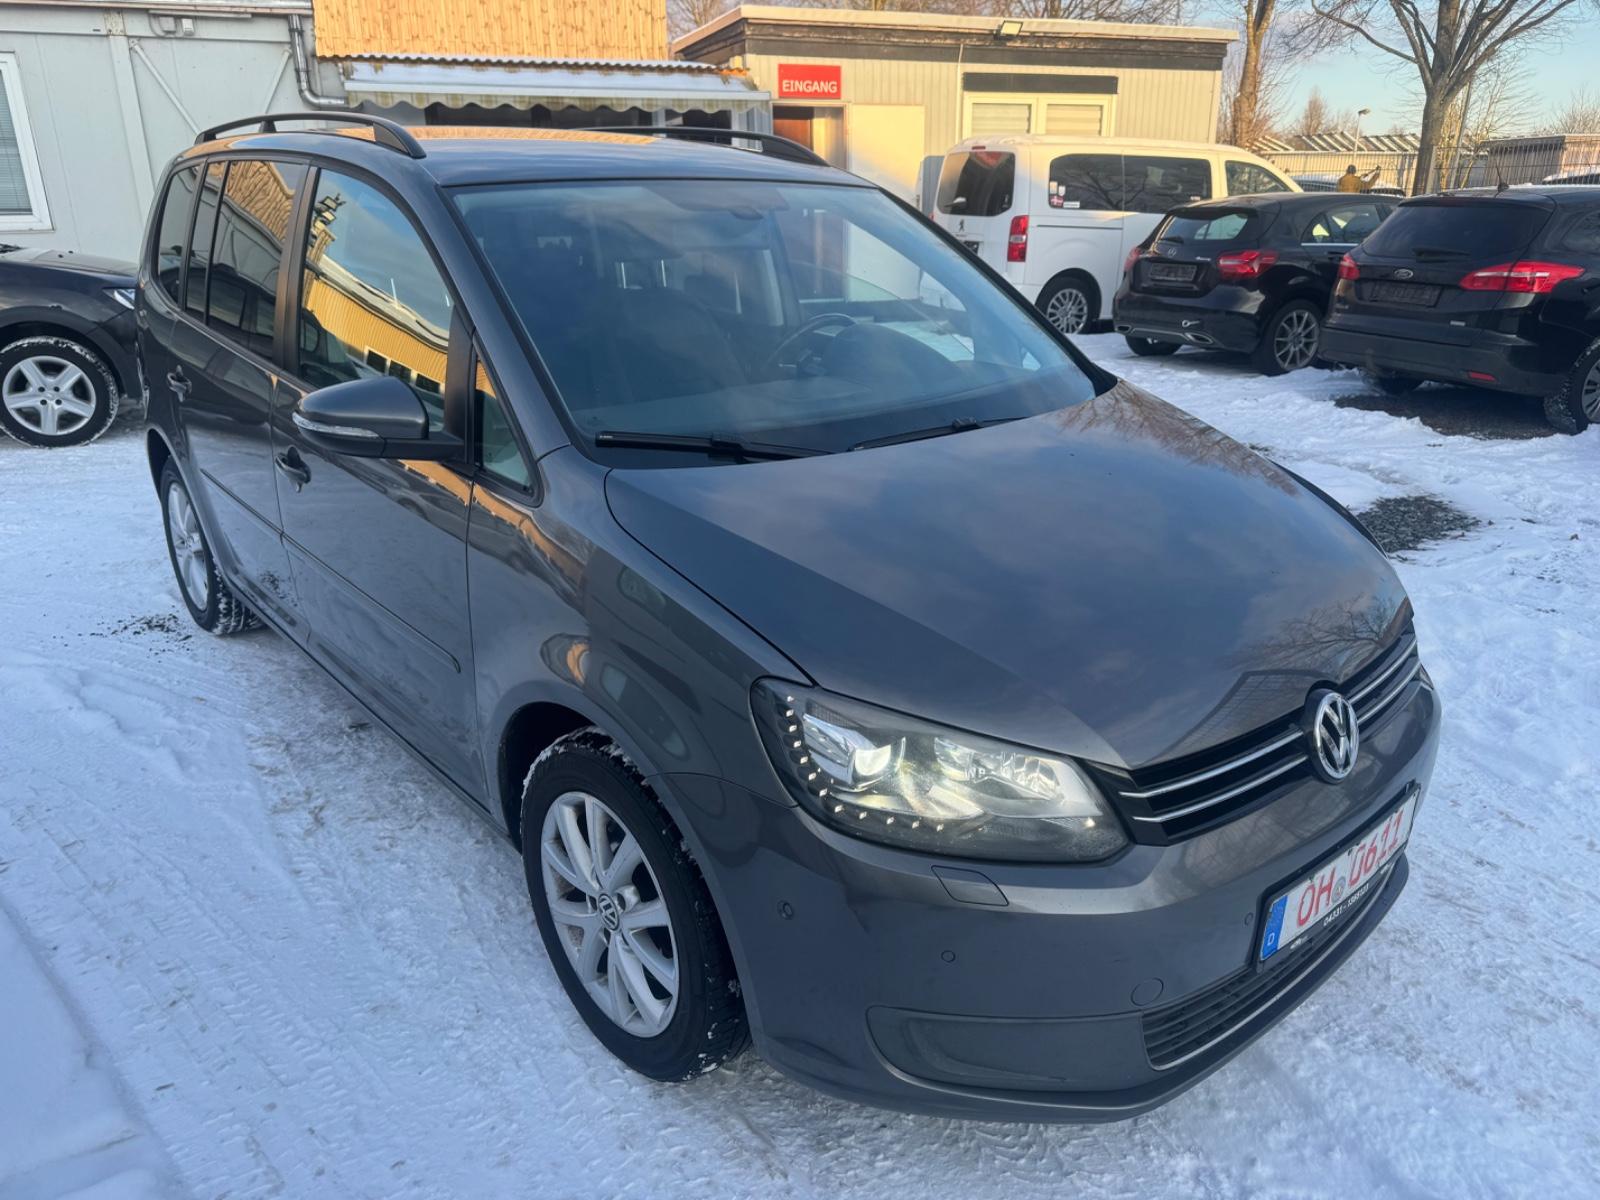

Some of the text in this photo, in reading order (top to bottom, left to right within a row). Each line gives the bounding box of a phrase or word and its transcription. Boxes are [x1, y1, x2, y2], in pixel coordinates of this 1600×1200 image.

[781, 79, 838, 93] EINGANG
[1297, 867, 1336, 927] OH
[1267, 932, 1275, 947] D
